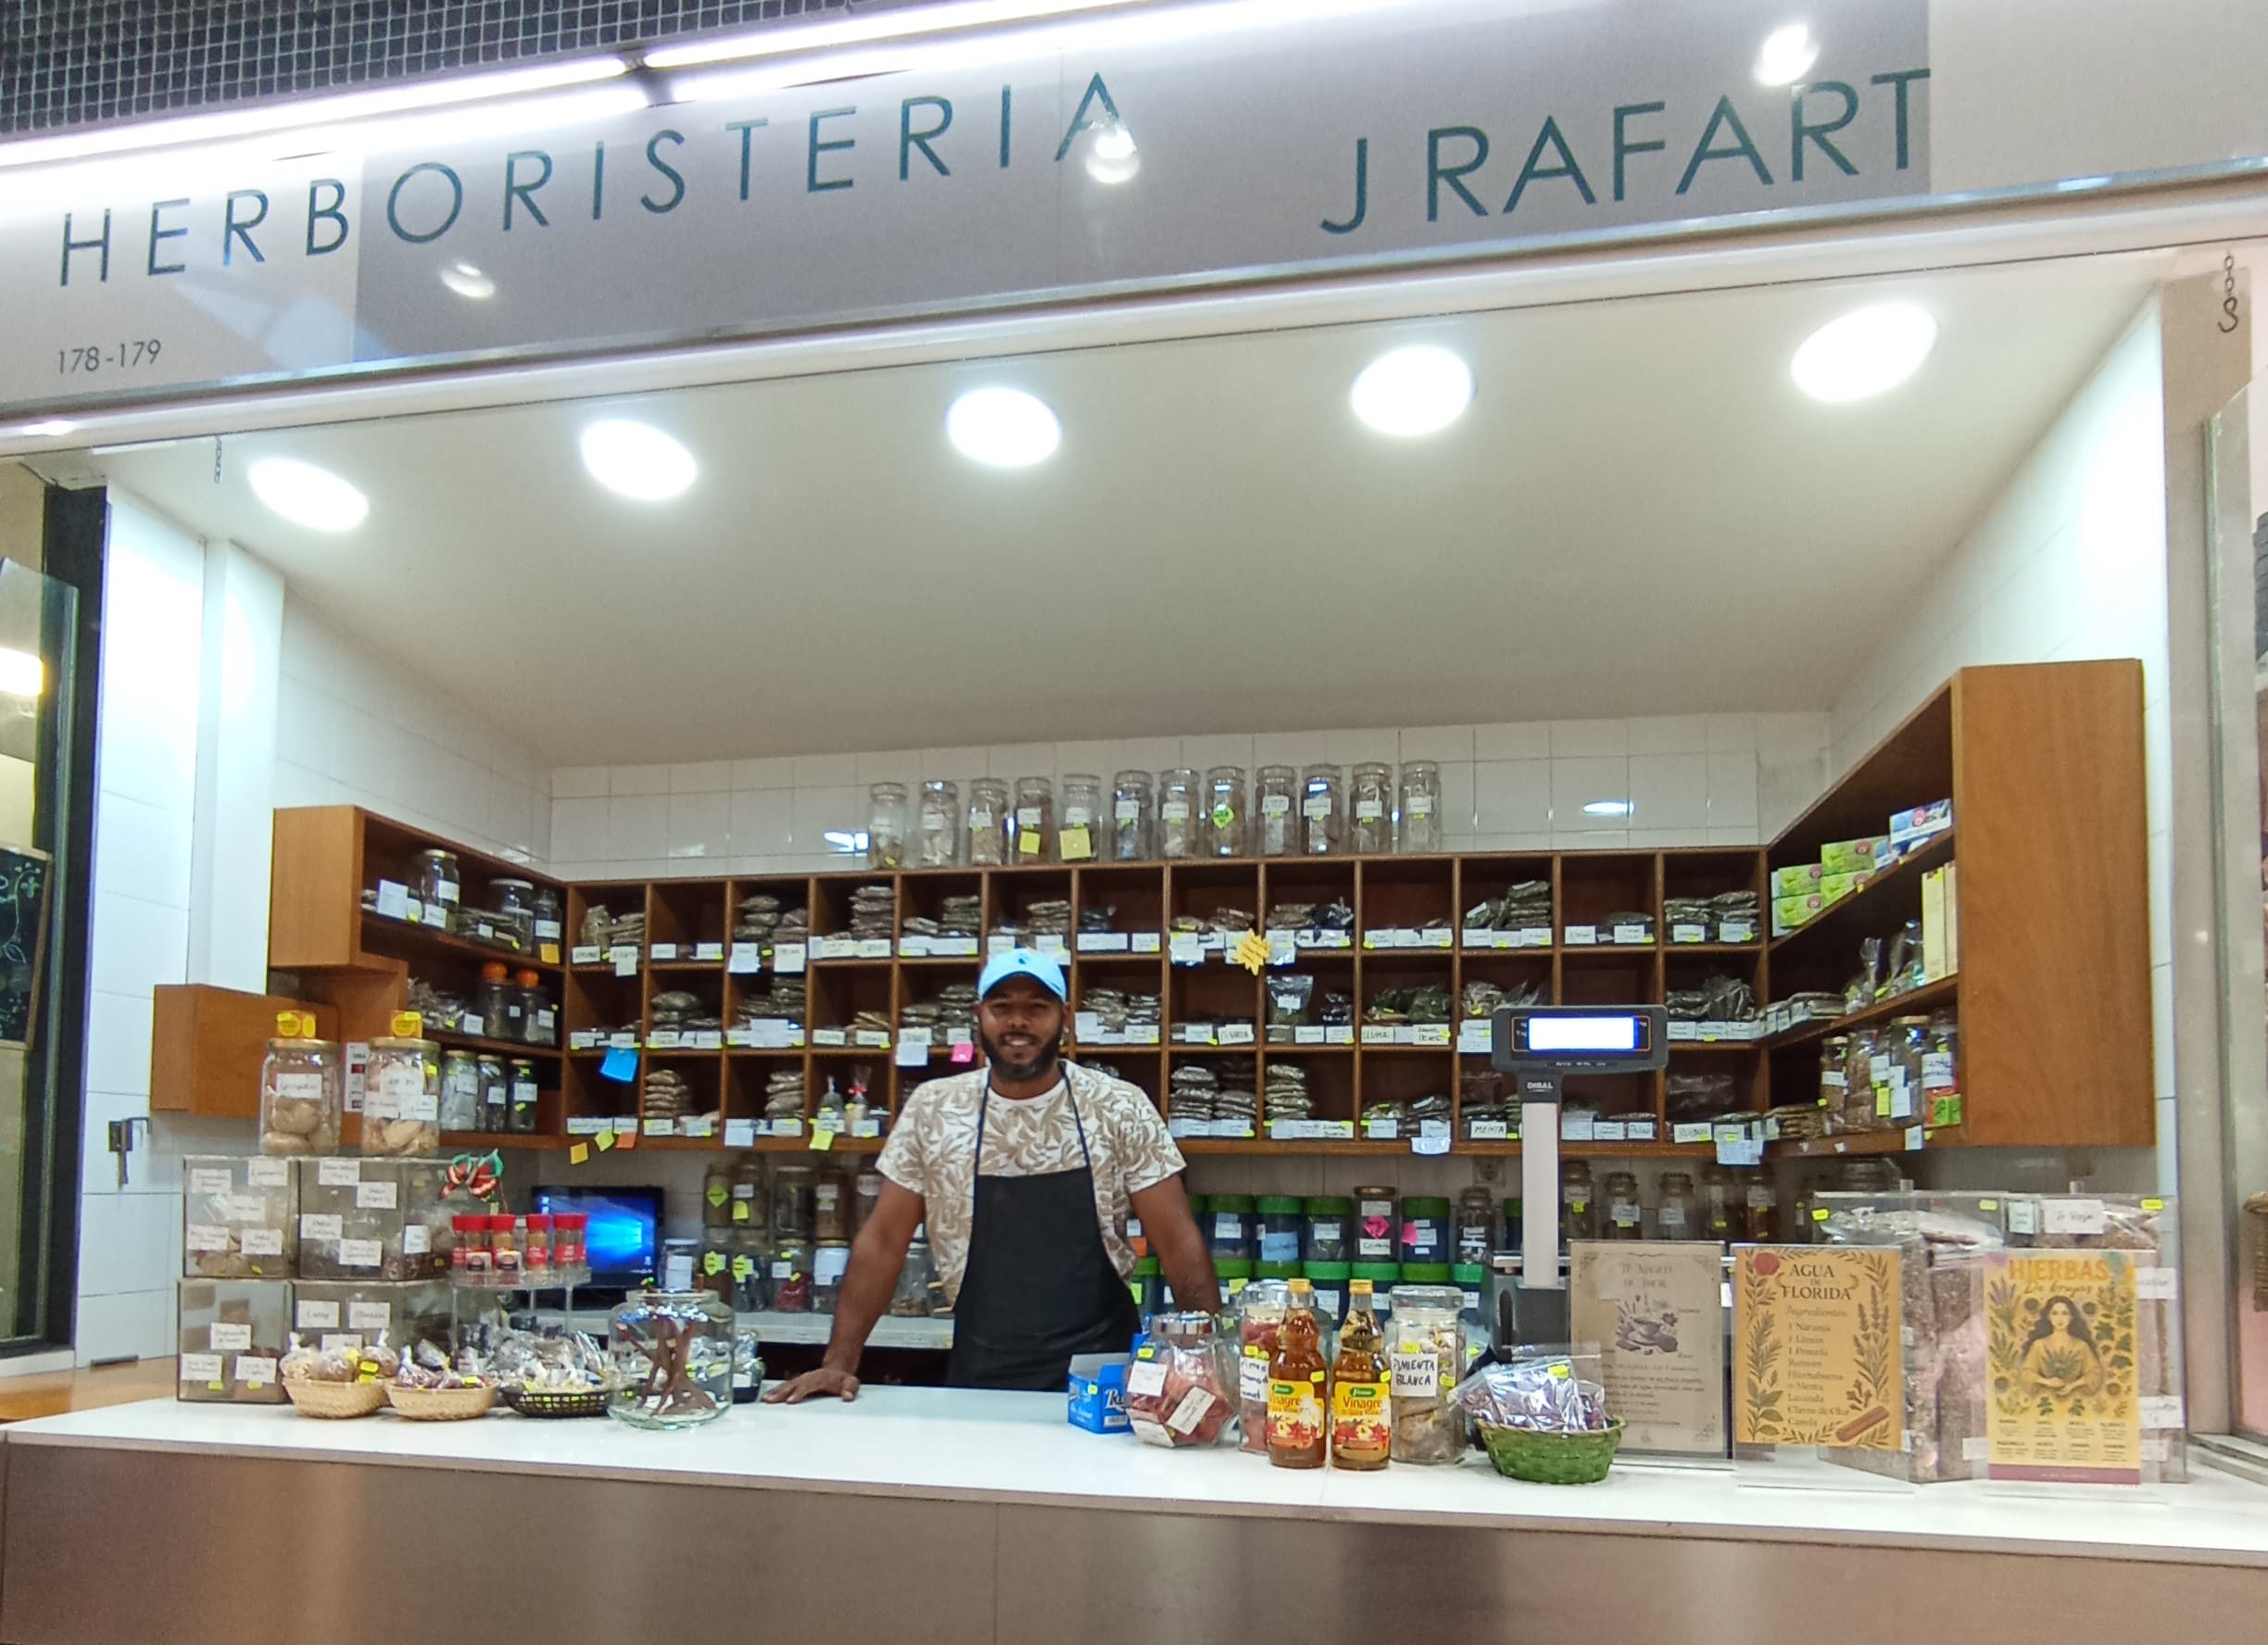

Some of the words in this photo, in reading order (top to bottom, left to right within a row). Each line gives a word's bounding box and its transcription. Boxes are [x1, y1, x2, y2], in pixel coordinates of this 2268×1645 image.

[1320, 138, 1370, 235] J
[1425, 68, 1932, 224] RAFART
[58, 72, 1127, 288] HERBORISTERIA
[57, 339, 162, 375] 178-179
[1527, 1081, 1554, 1089] DIBAL
[1789, 1263, 1834, 1278] AGUA
[2009, 1259, 2110, 1280] HIERBAS
[1781, 1285, 1851, 1300] FLORIDA
[1392, 1358, 1435, 1371] PIMIENTA
[1395, 1374, 1431, 1386] BLANCA
[1342, 1396, 1382, 1410] Vinagre
